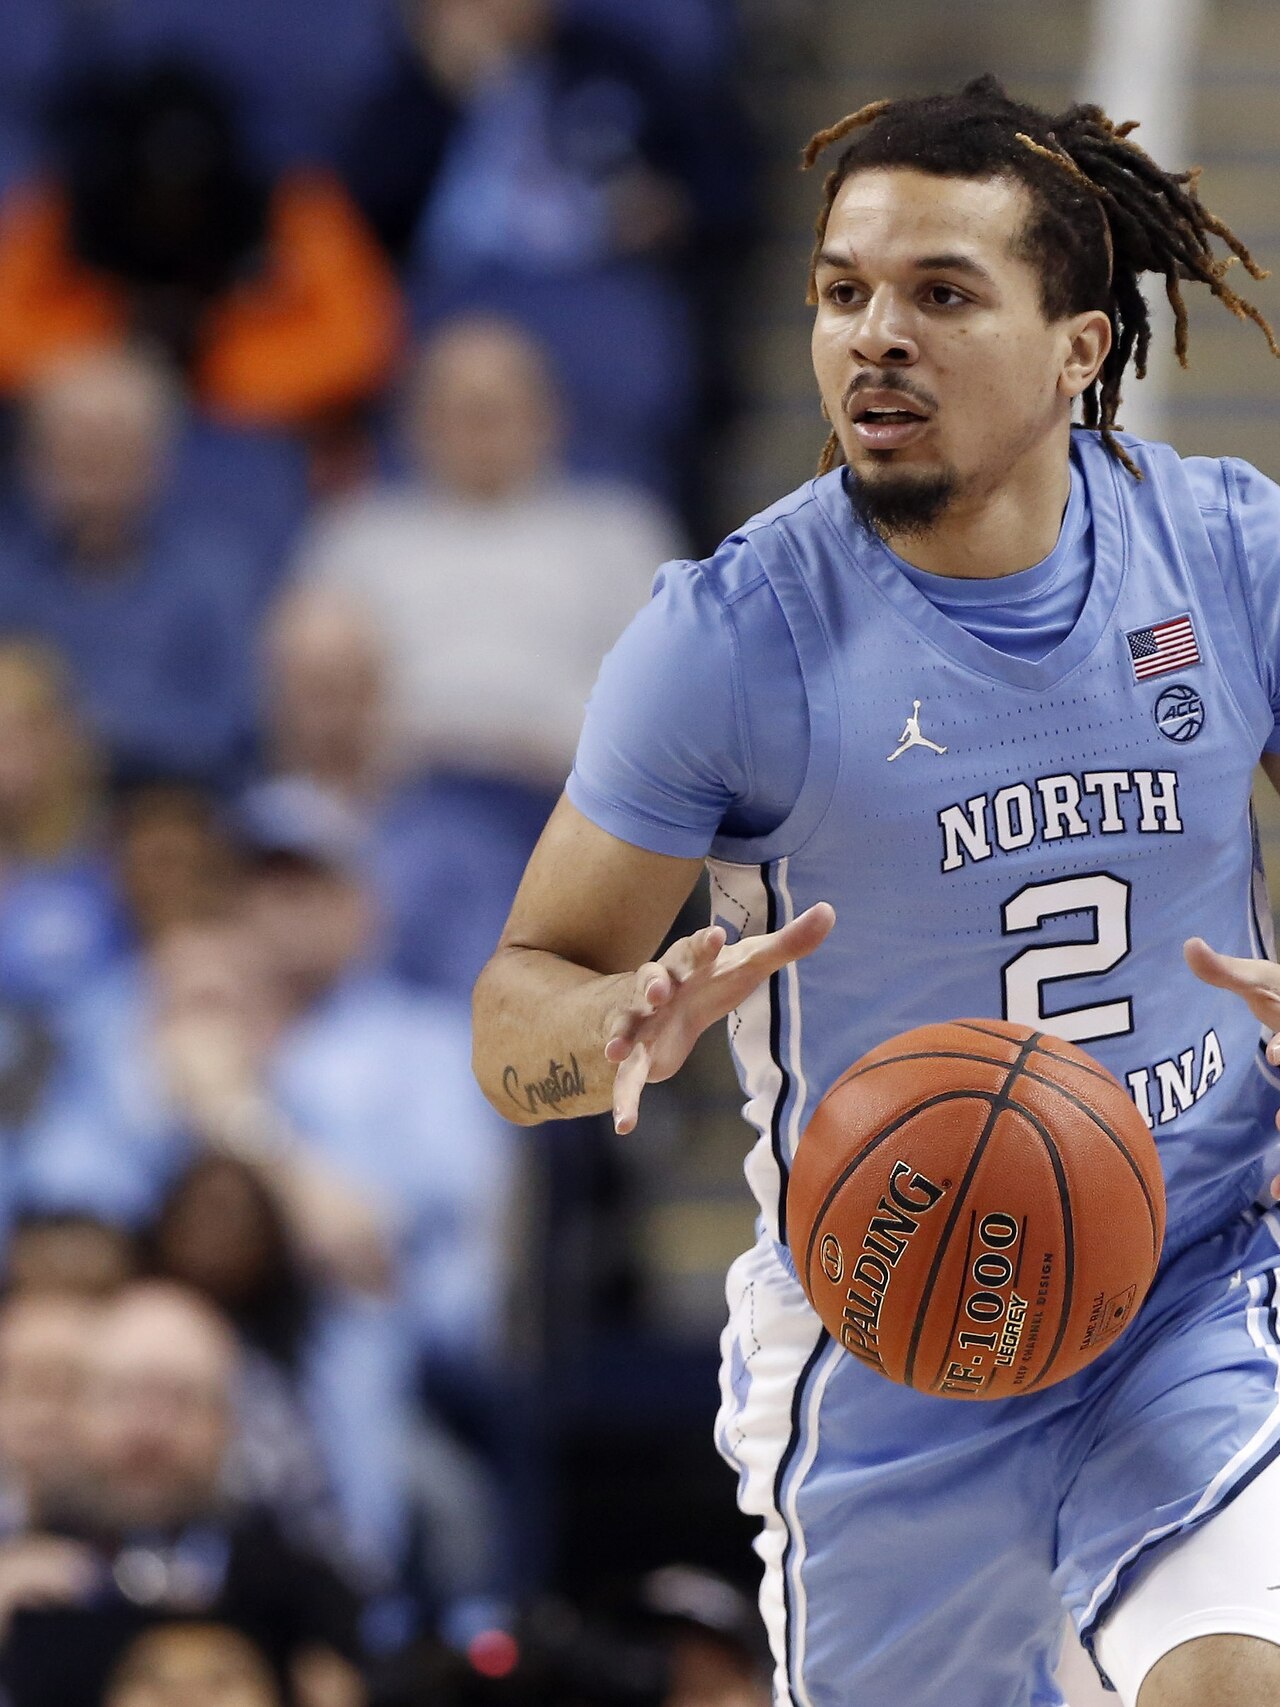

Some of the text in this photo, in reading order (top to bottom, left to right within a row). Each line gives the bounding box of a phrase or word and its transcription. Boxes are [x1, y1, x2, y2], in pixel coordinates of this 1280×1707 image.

[1163, 699, 1200, 721] ACC
[937, 769, 1184, 873] NORTH
[1000, 870, 1134, 1044] 2
[840, 1160, 947, 1374] PALDING
[1022, 1311, 1044, 1361] CHANNEL
[1037, 1252, 1054, 1306] DESIGN
[1090, 1292, 1105, 1322] BALL
[995, 1291, 1029, 1367] LEGACY
